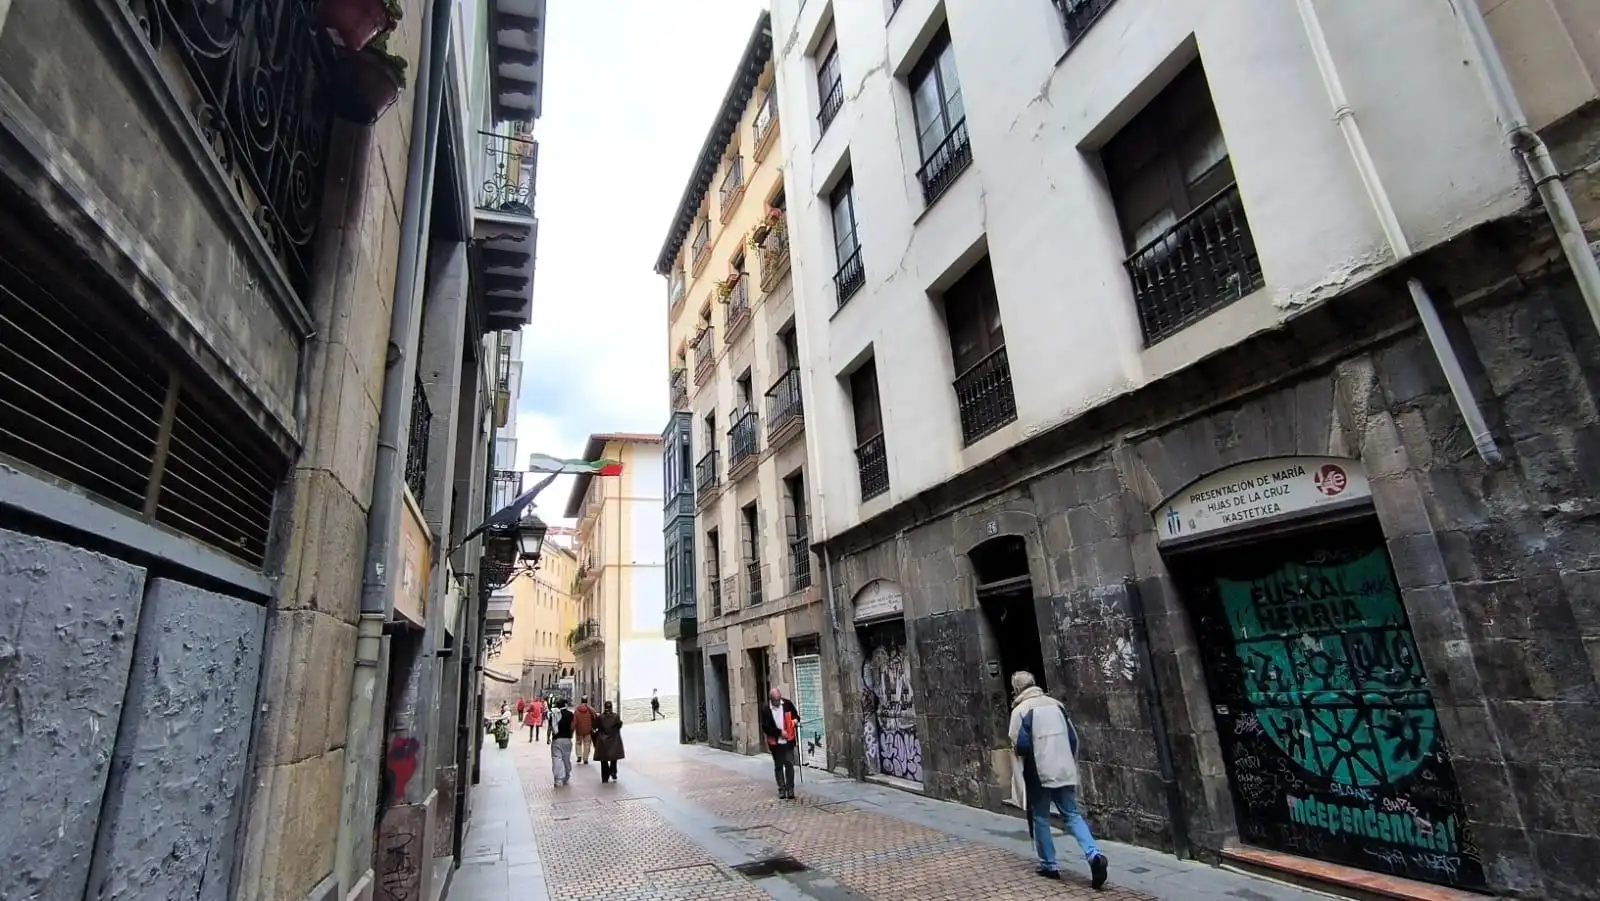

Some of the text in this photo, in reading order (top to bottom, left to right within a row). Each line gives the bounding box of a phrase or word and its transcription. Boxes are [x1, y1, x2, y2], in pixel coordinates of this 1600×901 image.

[1190, 464, 1306, 504] PRESENTACIÓN DE MARÍA
[1208, 484, 1291, 512] HIJAS DE LA CRUZ
[1222, 503, 1282, 524] IKASTETXEA
[1251, 572, 1357, 607] EUSKAL
[1255, 599, 1364, 632] HERRIA
